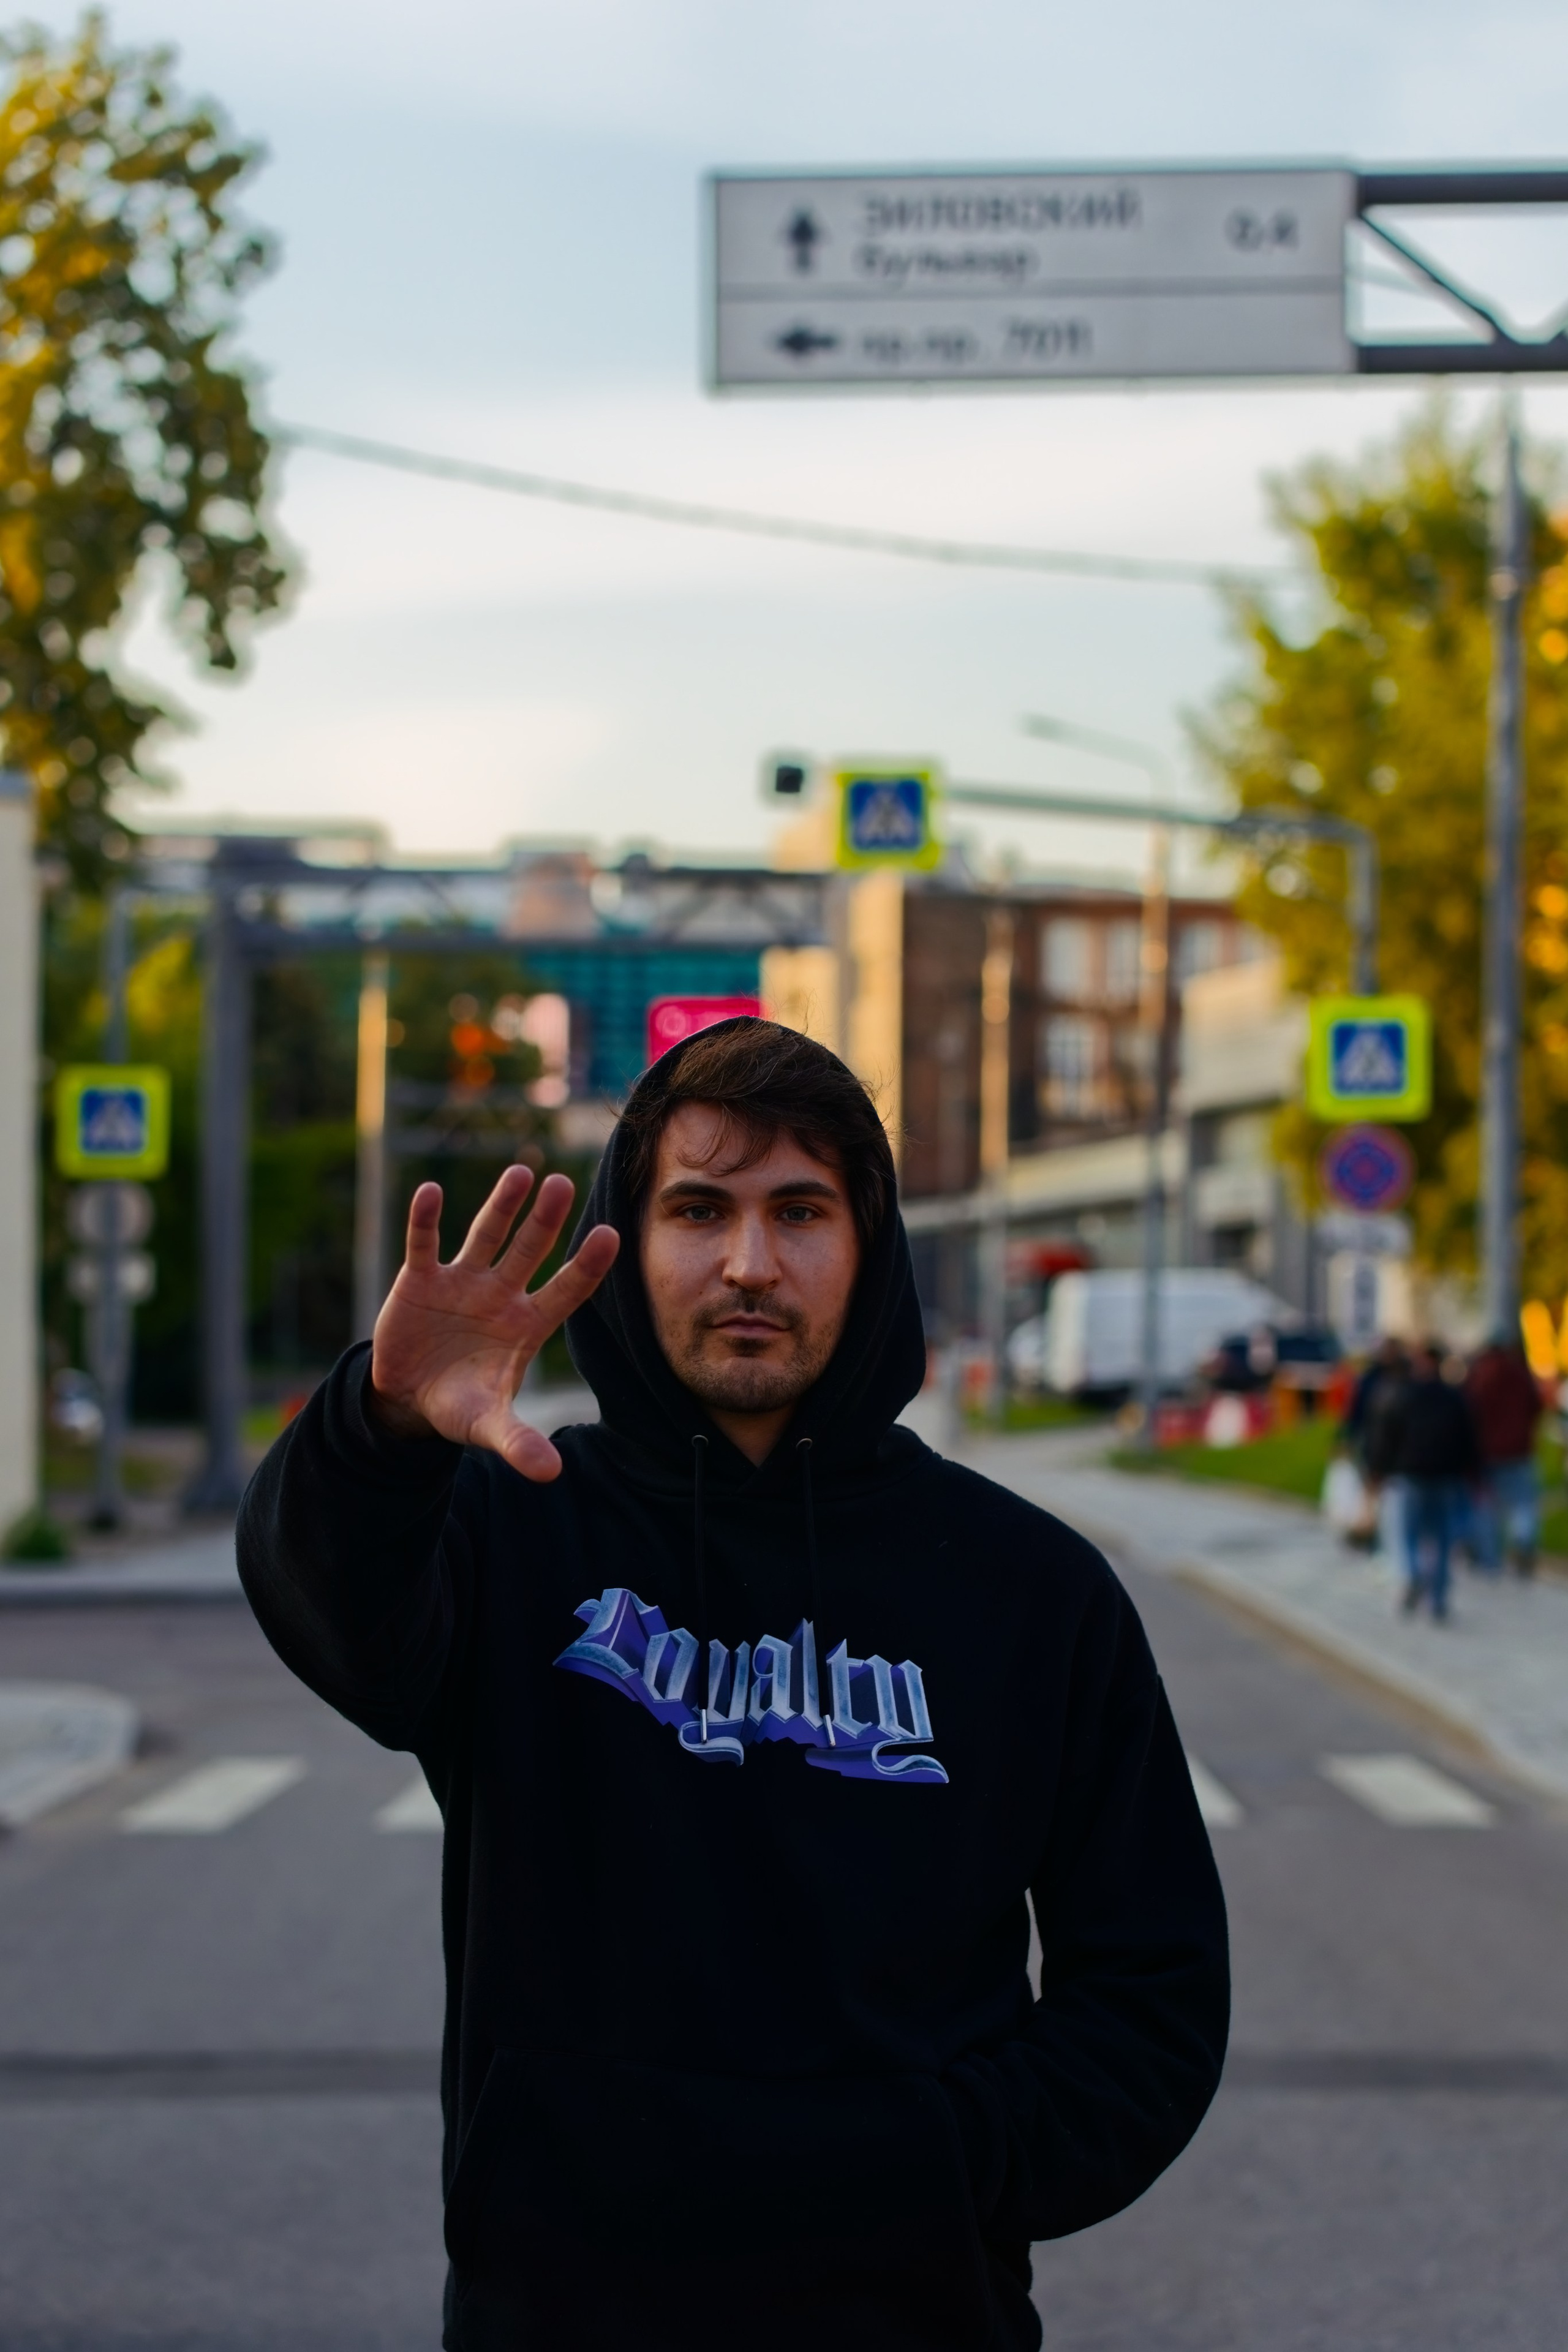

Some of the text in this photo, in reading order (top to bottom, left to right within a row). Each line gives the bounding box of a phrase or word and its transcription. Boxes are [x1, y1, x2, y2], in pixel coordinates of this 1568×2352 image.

[859, 186, 1138, 233] ЗИЛОВСКИЙ
[858, 241, 1036, 286] бульвар
[1005, 318, 1090, 358] 7011
[552, 1588, 948, 1784] Loyalty
